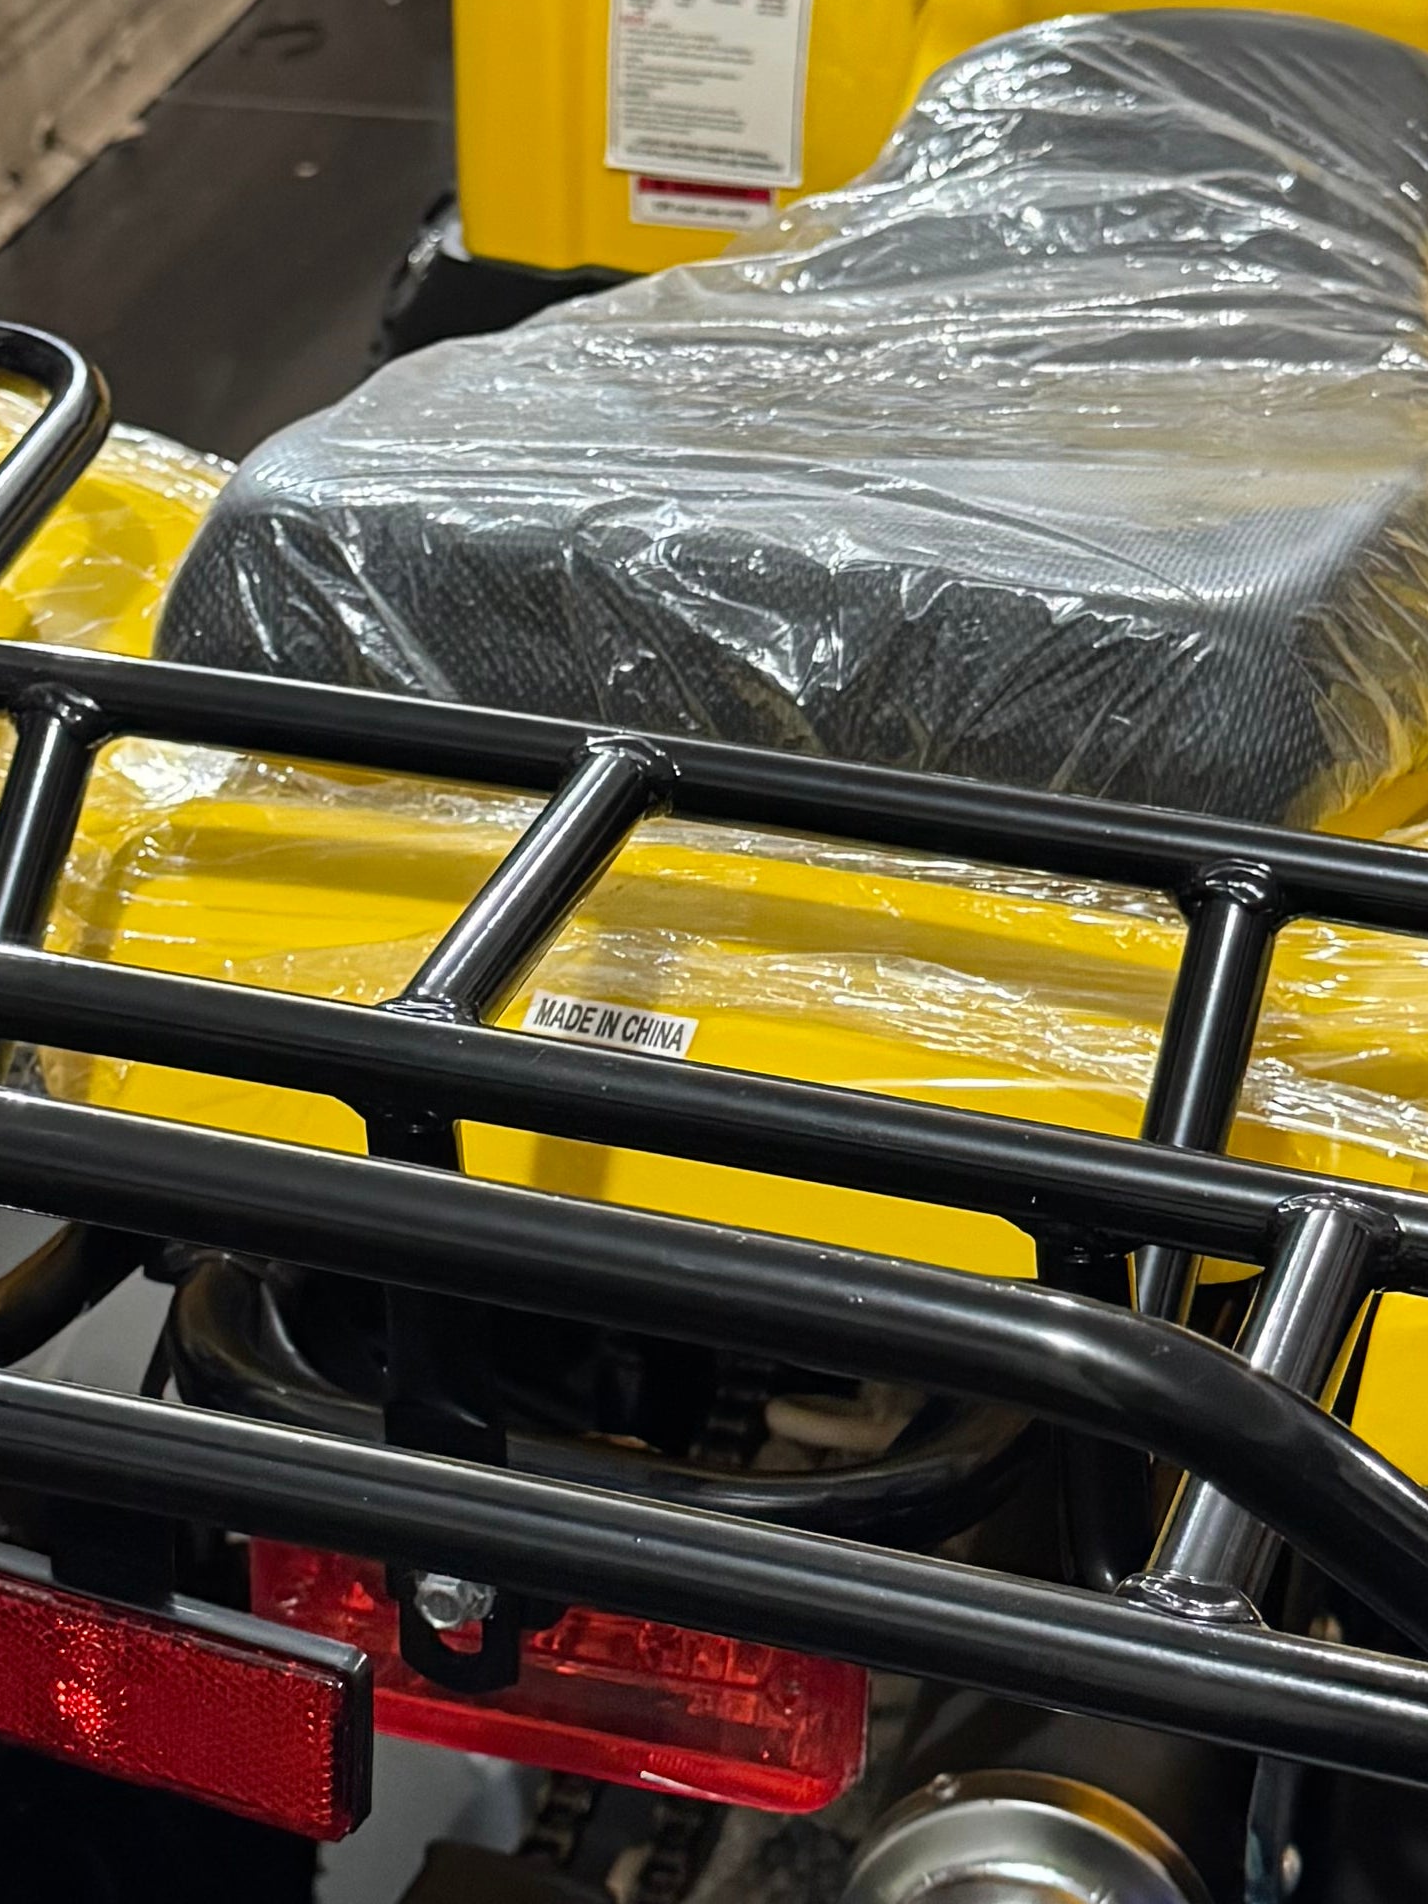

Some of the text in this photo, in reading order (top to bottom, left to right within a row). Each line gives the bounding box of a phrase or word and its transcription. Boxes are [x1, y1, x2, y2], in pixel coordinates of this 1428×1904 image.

[532, 998, 685, 1053] MADE IN CHINA
